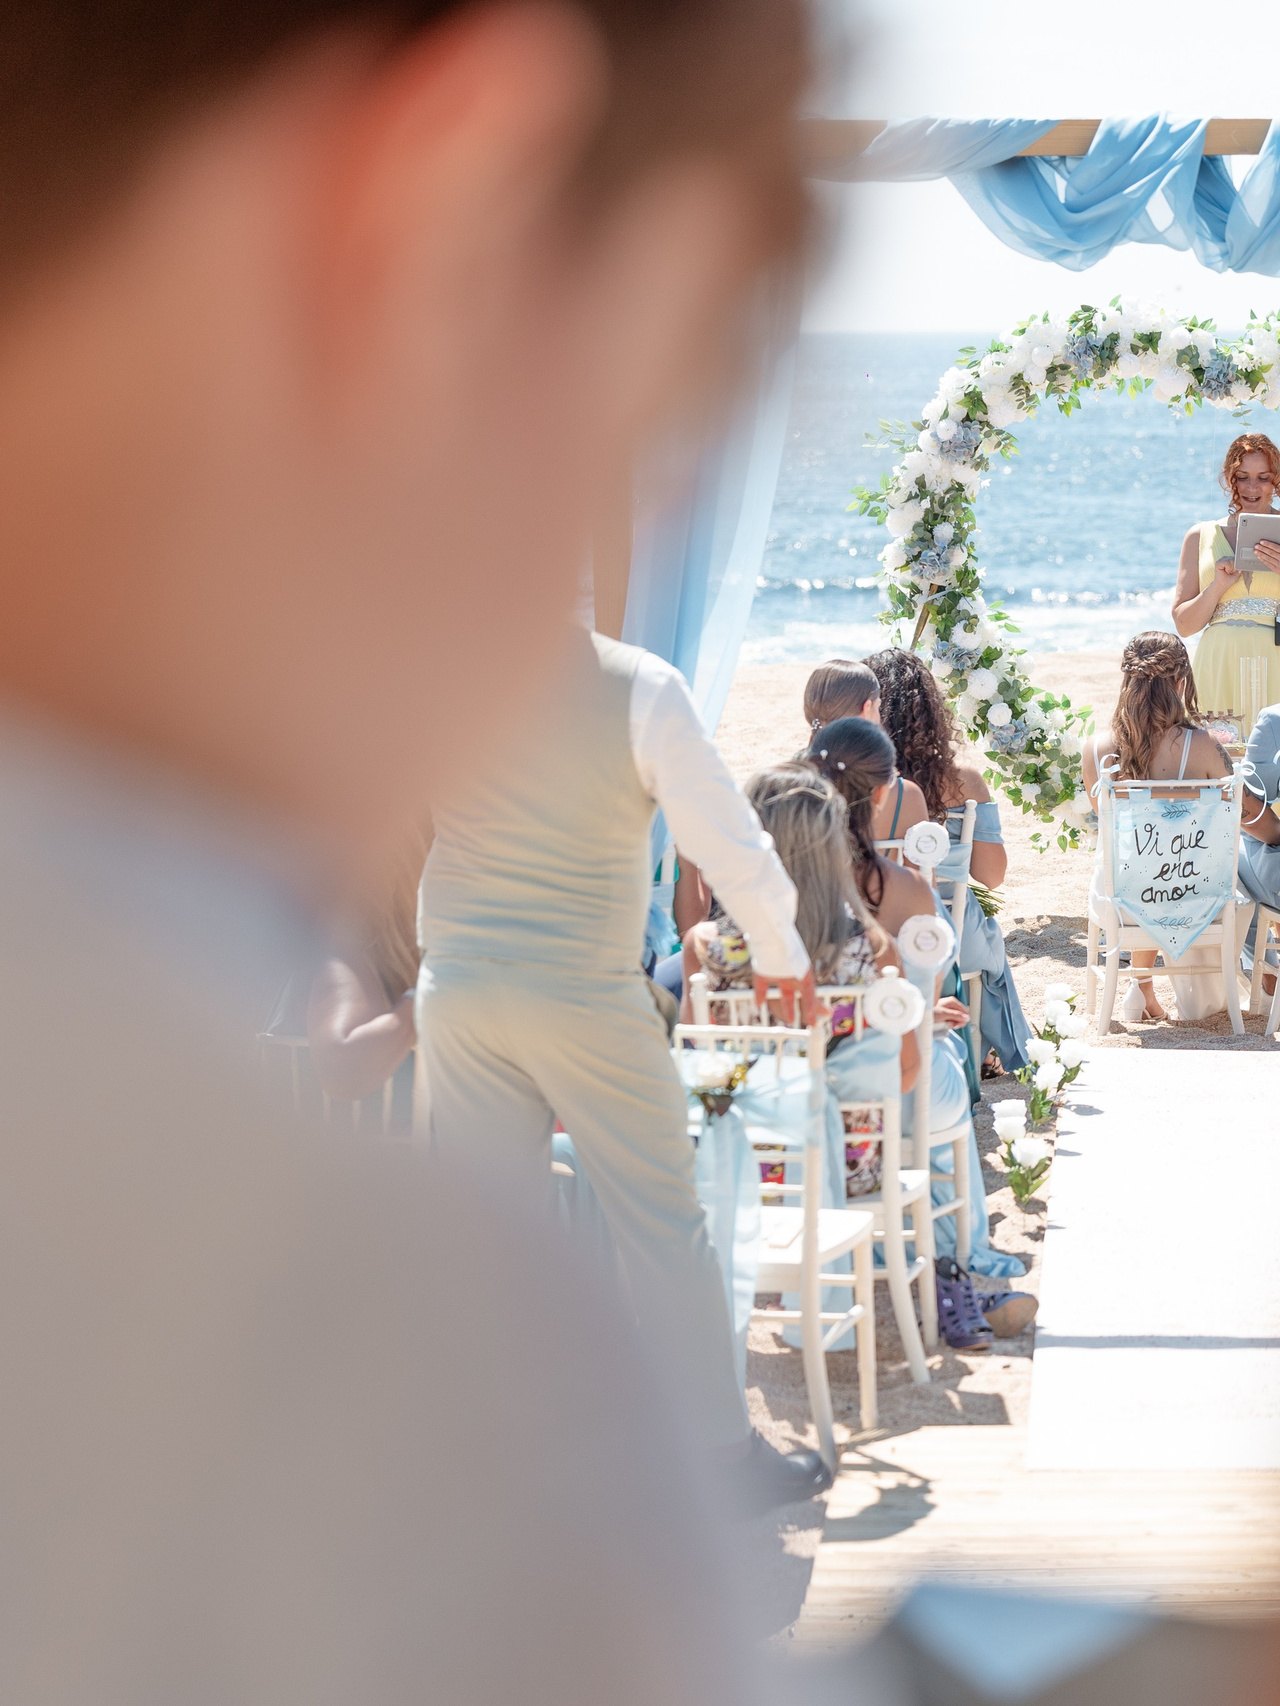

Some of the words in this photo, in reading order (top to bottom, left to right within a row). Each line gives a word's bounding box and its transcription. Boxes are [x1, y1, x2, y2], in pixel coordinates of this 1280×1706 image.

[1135, 823, 1163, 856] Vi
[1171, 830, 1209, 861] que
[1153, 861, 1200, 881] era
[1141, 884, 1200, 903] amor
